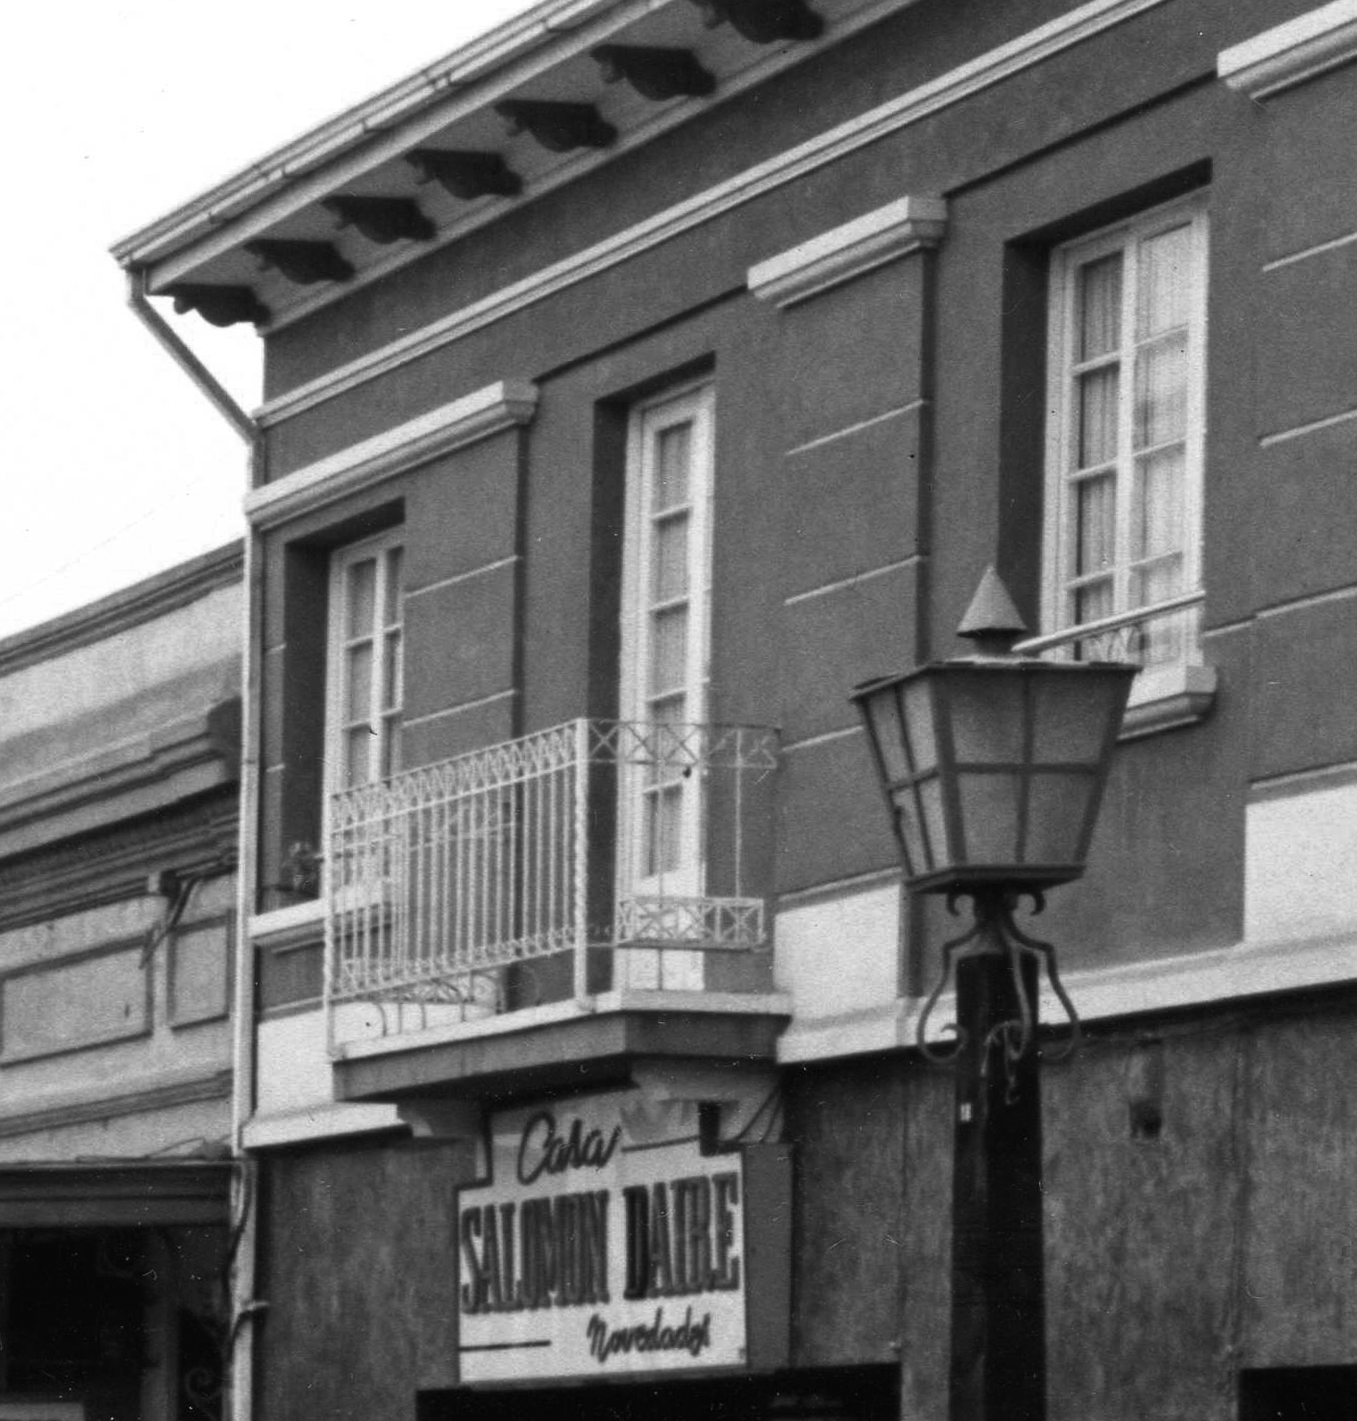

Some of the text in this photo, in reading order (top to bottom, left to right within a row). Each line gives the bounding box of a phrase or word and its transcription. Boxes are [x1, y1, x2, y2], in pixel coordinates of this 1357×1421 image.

[517, 1111, 622, 1187] Casa
[460, 1171, 739, 1315] SALOMON DAIRE
[587, 1304, 711, 1364] Novedades
